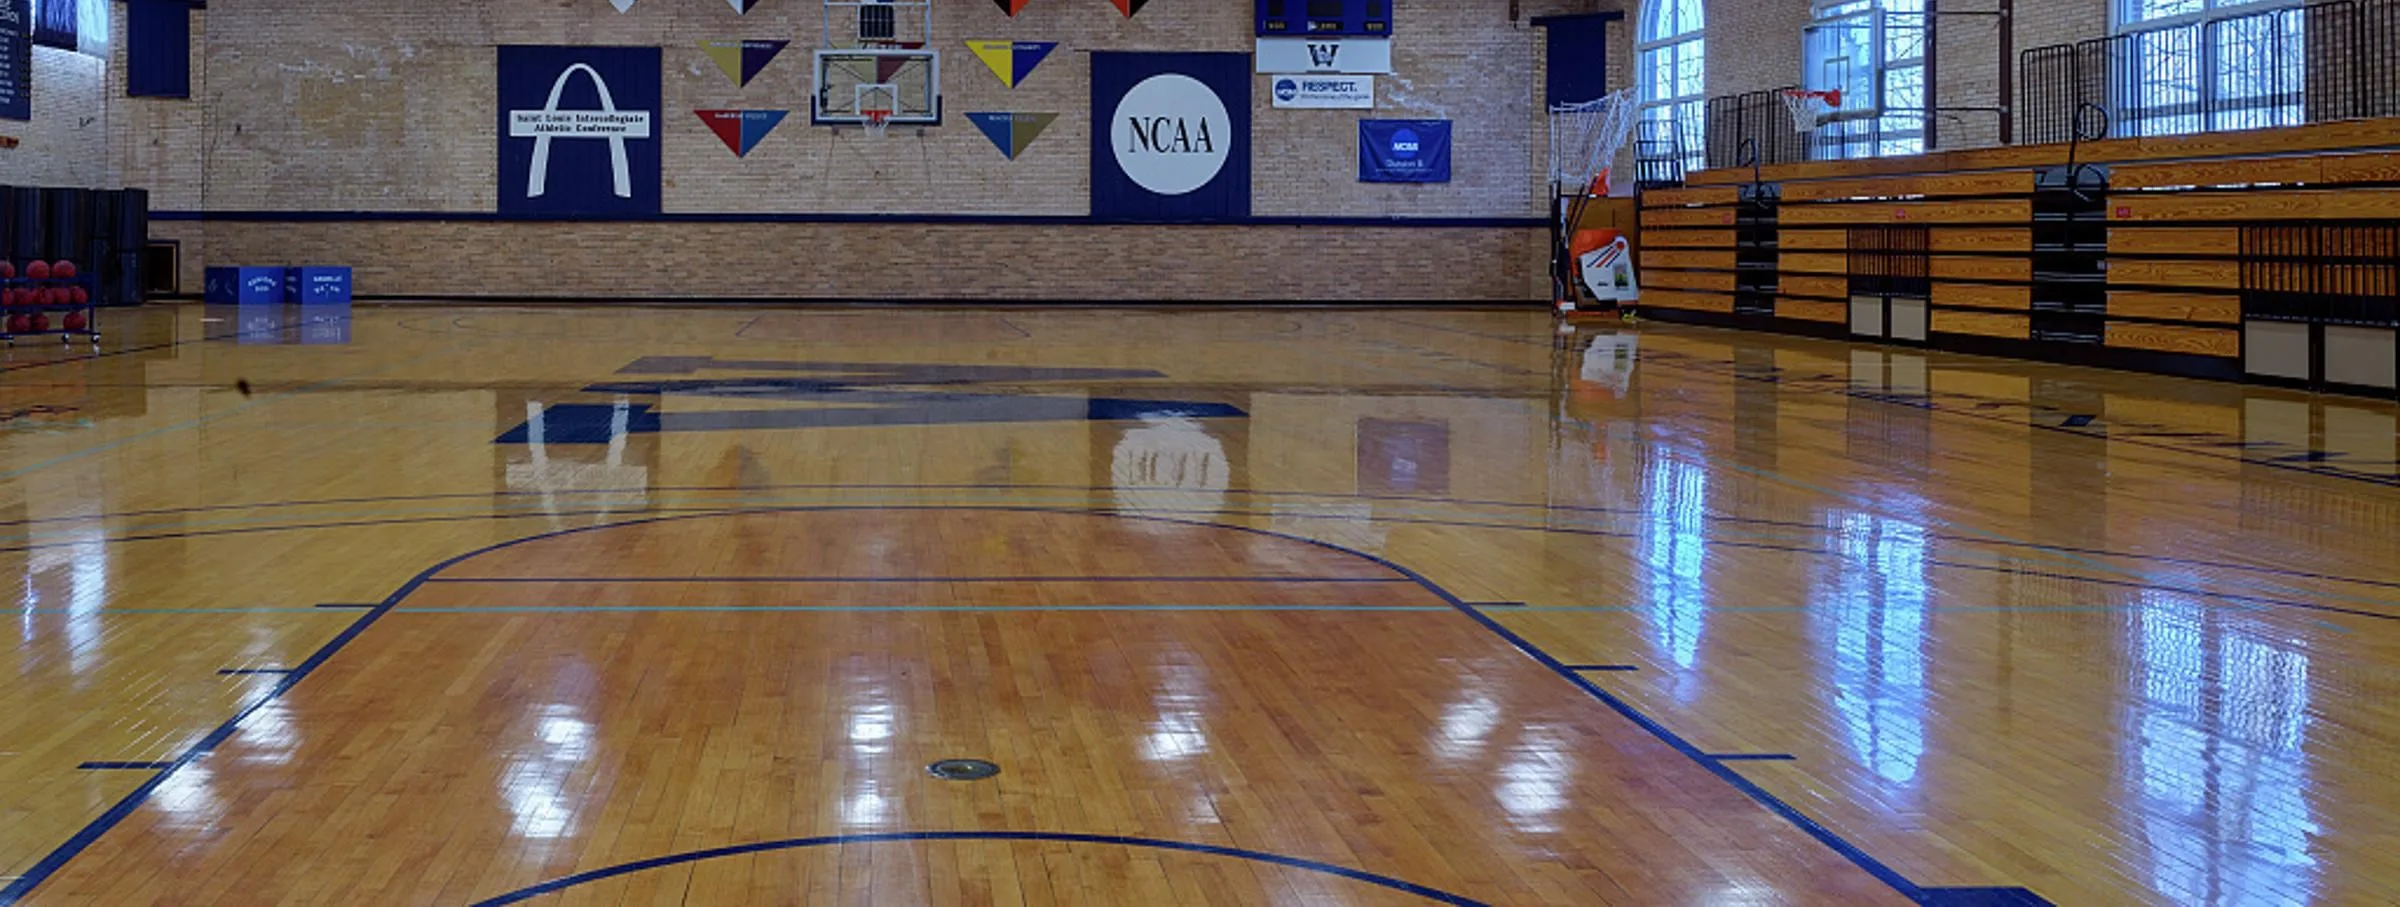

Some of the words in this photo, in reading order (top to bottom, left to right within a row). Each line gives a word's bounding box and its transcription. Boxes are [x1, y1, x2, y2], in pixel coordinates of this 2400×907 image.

[1307, 44, 1339, 67] W
[534, 123, 571, 132] Athletic
[575, 123, 627, 132] Conference
[1128, 116, 1215, 153] NCAA
